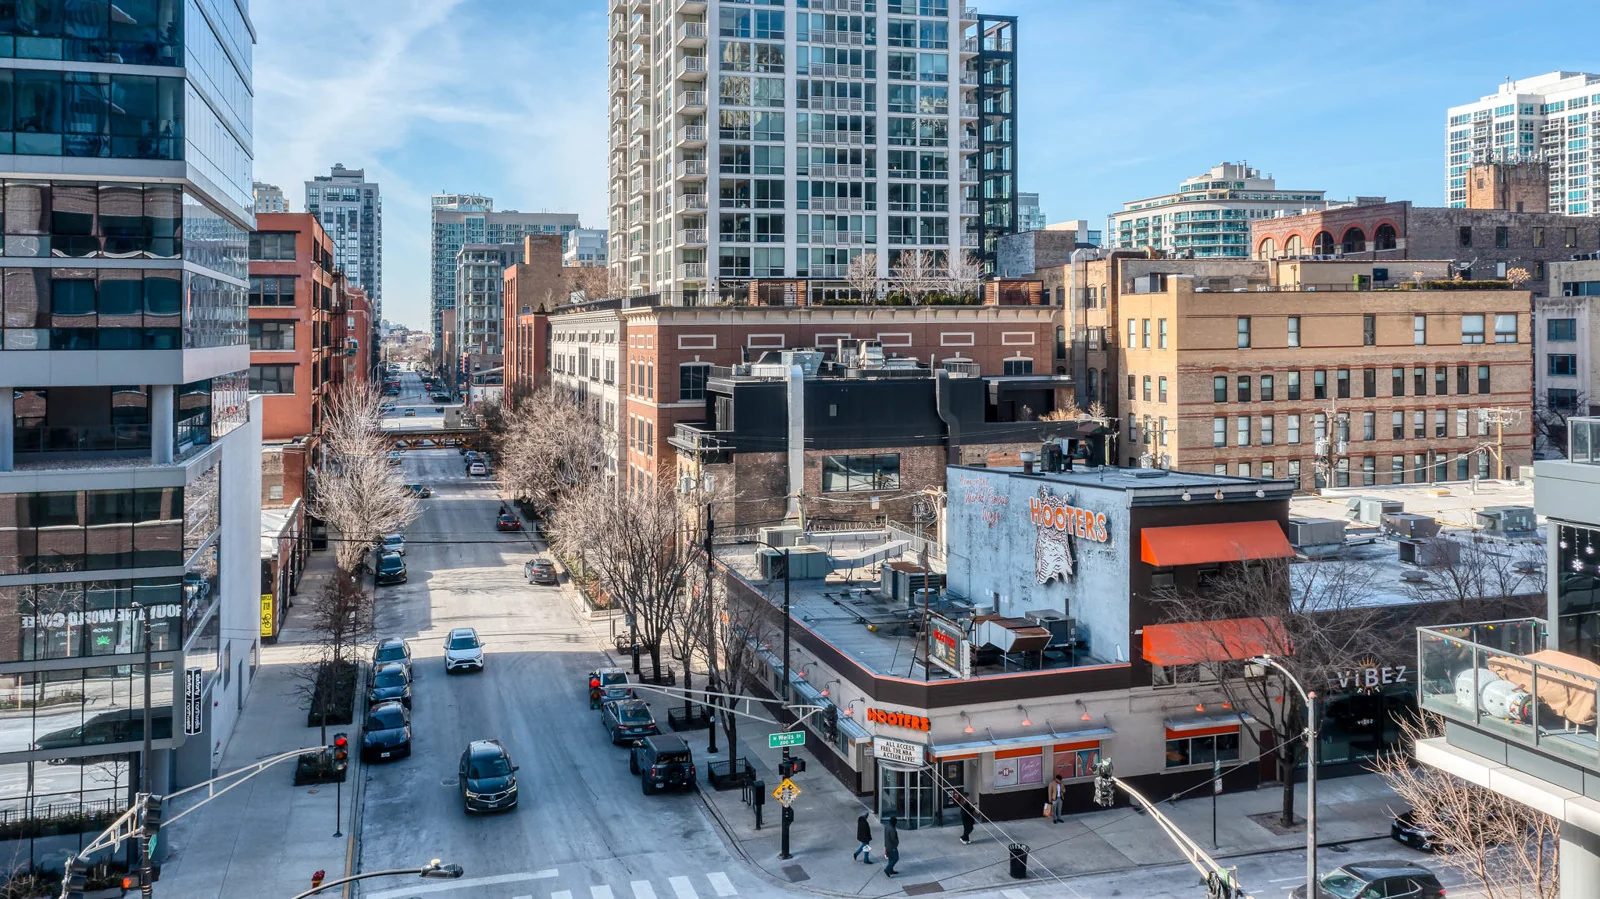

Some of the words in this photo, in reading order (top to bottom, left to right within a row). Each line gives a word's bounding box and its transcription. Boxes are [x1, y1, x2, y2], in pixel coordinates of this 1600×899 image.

[1029, 496, 1107, 543] HOOTERS
[1357, 687, 1380, 696] FIT
[867, 707, 930, 733] HOOTERS
[896, 743, 915, 751] ACCESS
[883, 752, 901, 760] ACTION
